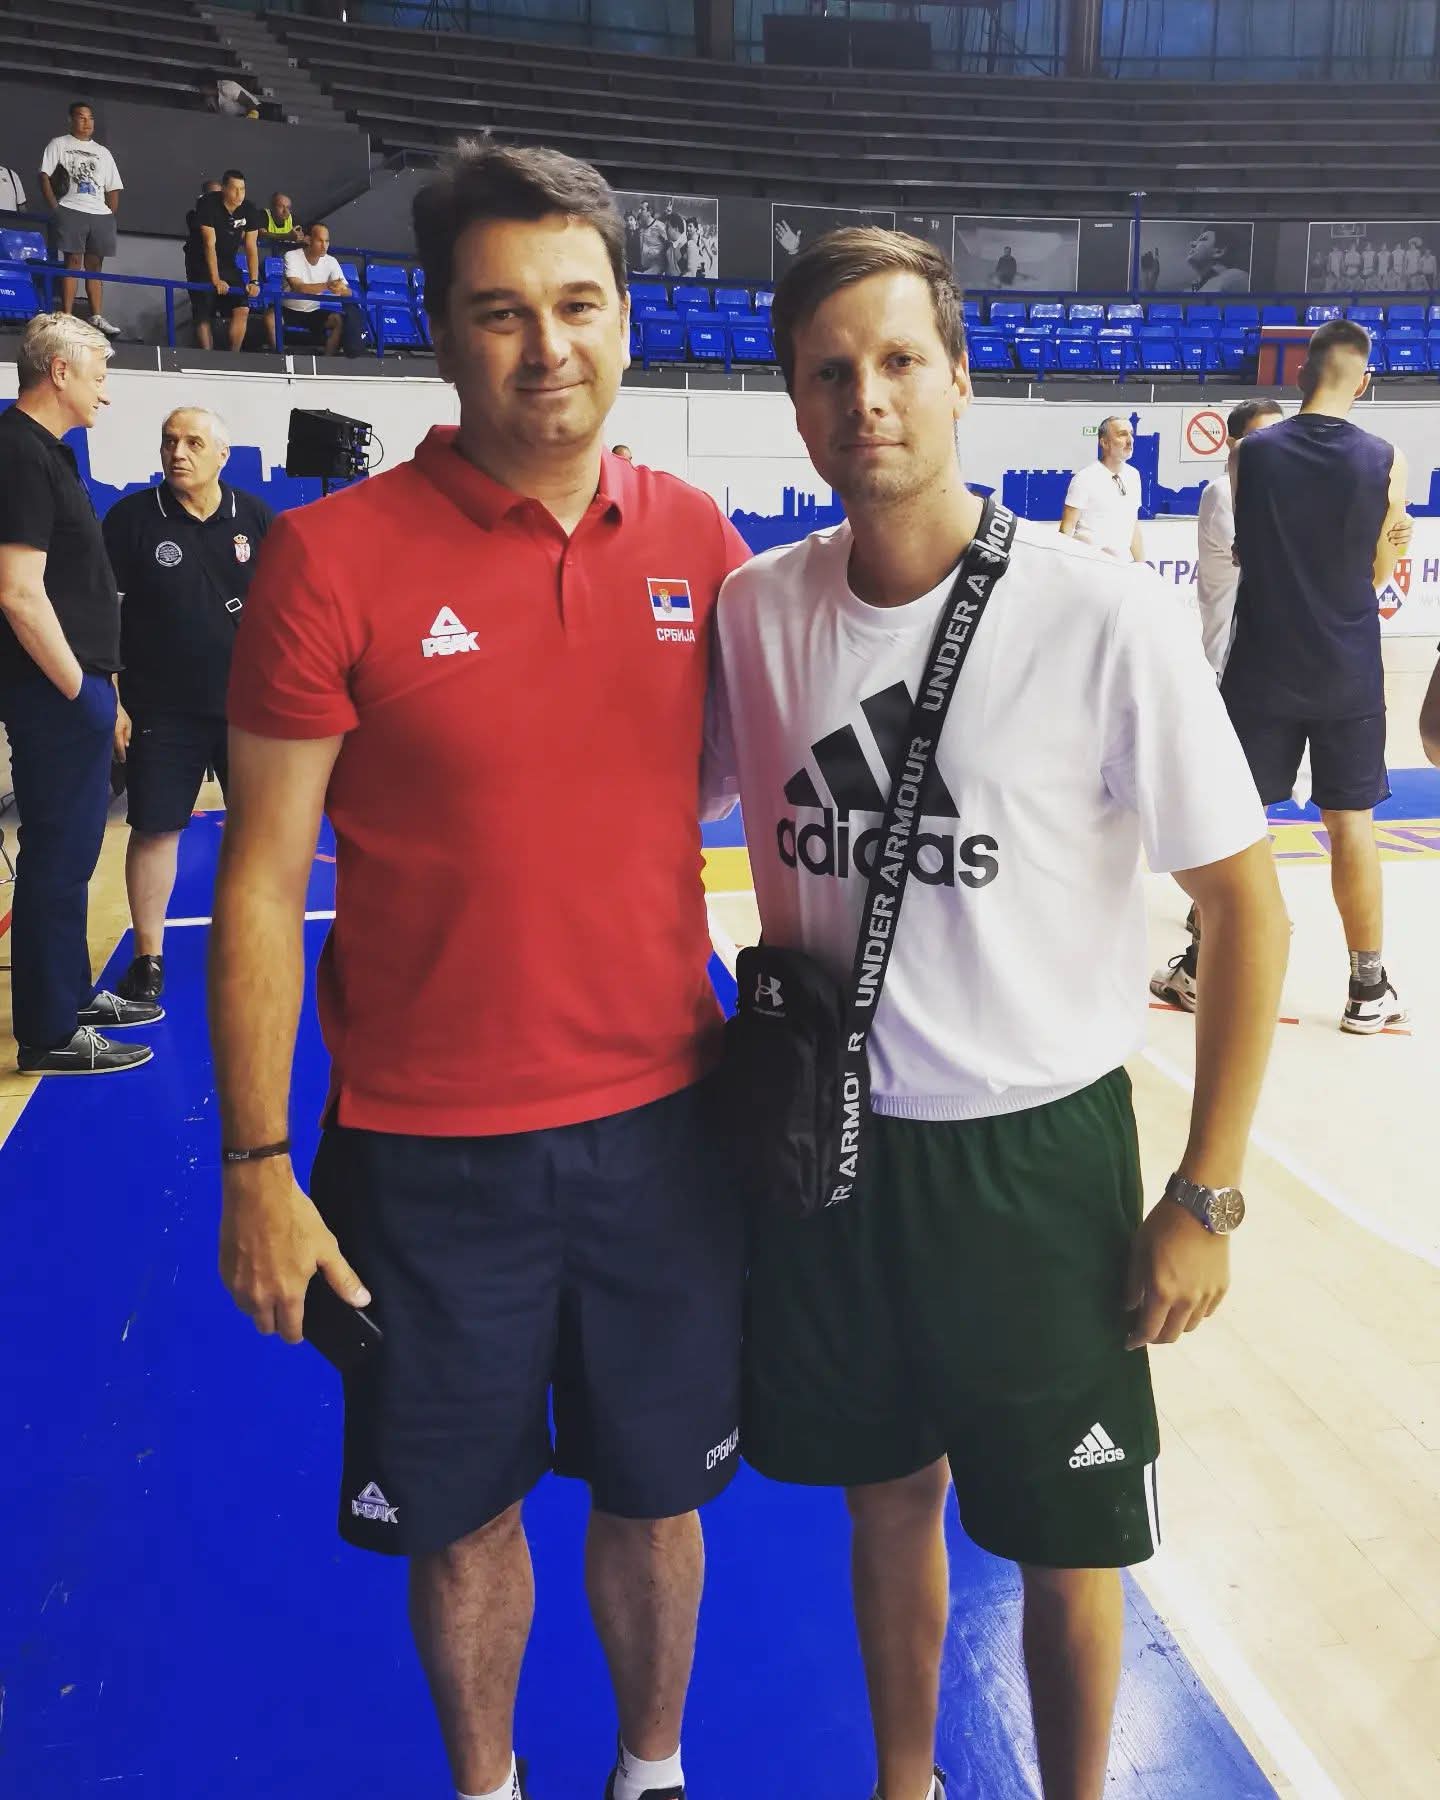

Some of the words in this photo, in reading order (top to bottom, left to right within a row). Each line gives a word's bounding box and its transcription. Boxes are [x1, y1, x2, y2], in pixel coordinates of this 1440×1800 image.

[656, 627, 696, 643] СРБИЈА
[921, 599, 979, 712] UNDER
[854, 893, 896, 1008] UNDER
[879, 736, 932, 888] ARMOUR
[1068, 1447, 1126, 1469] adidas
